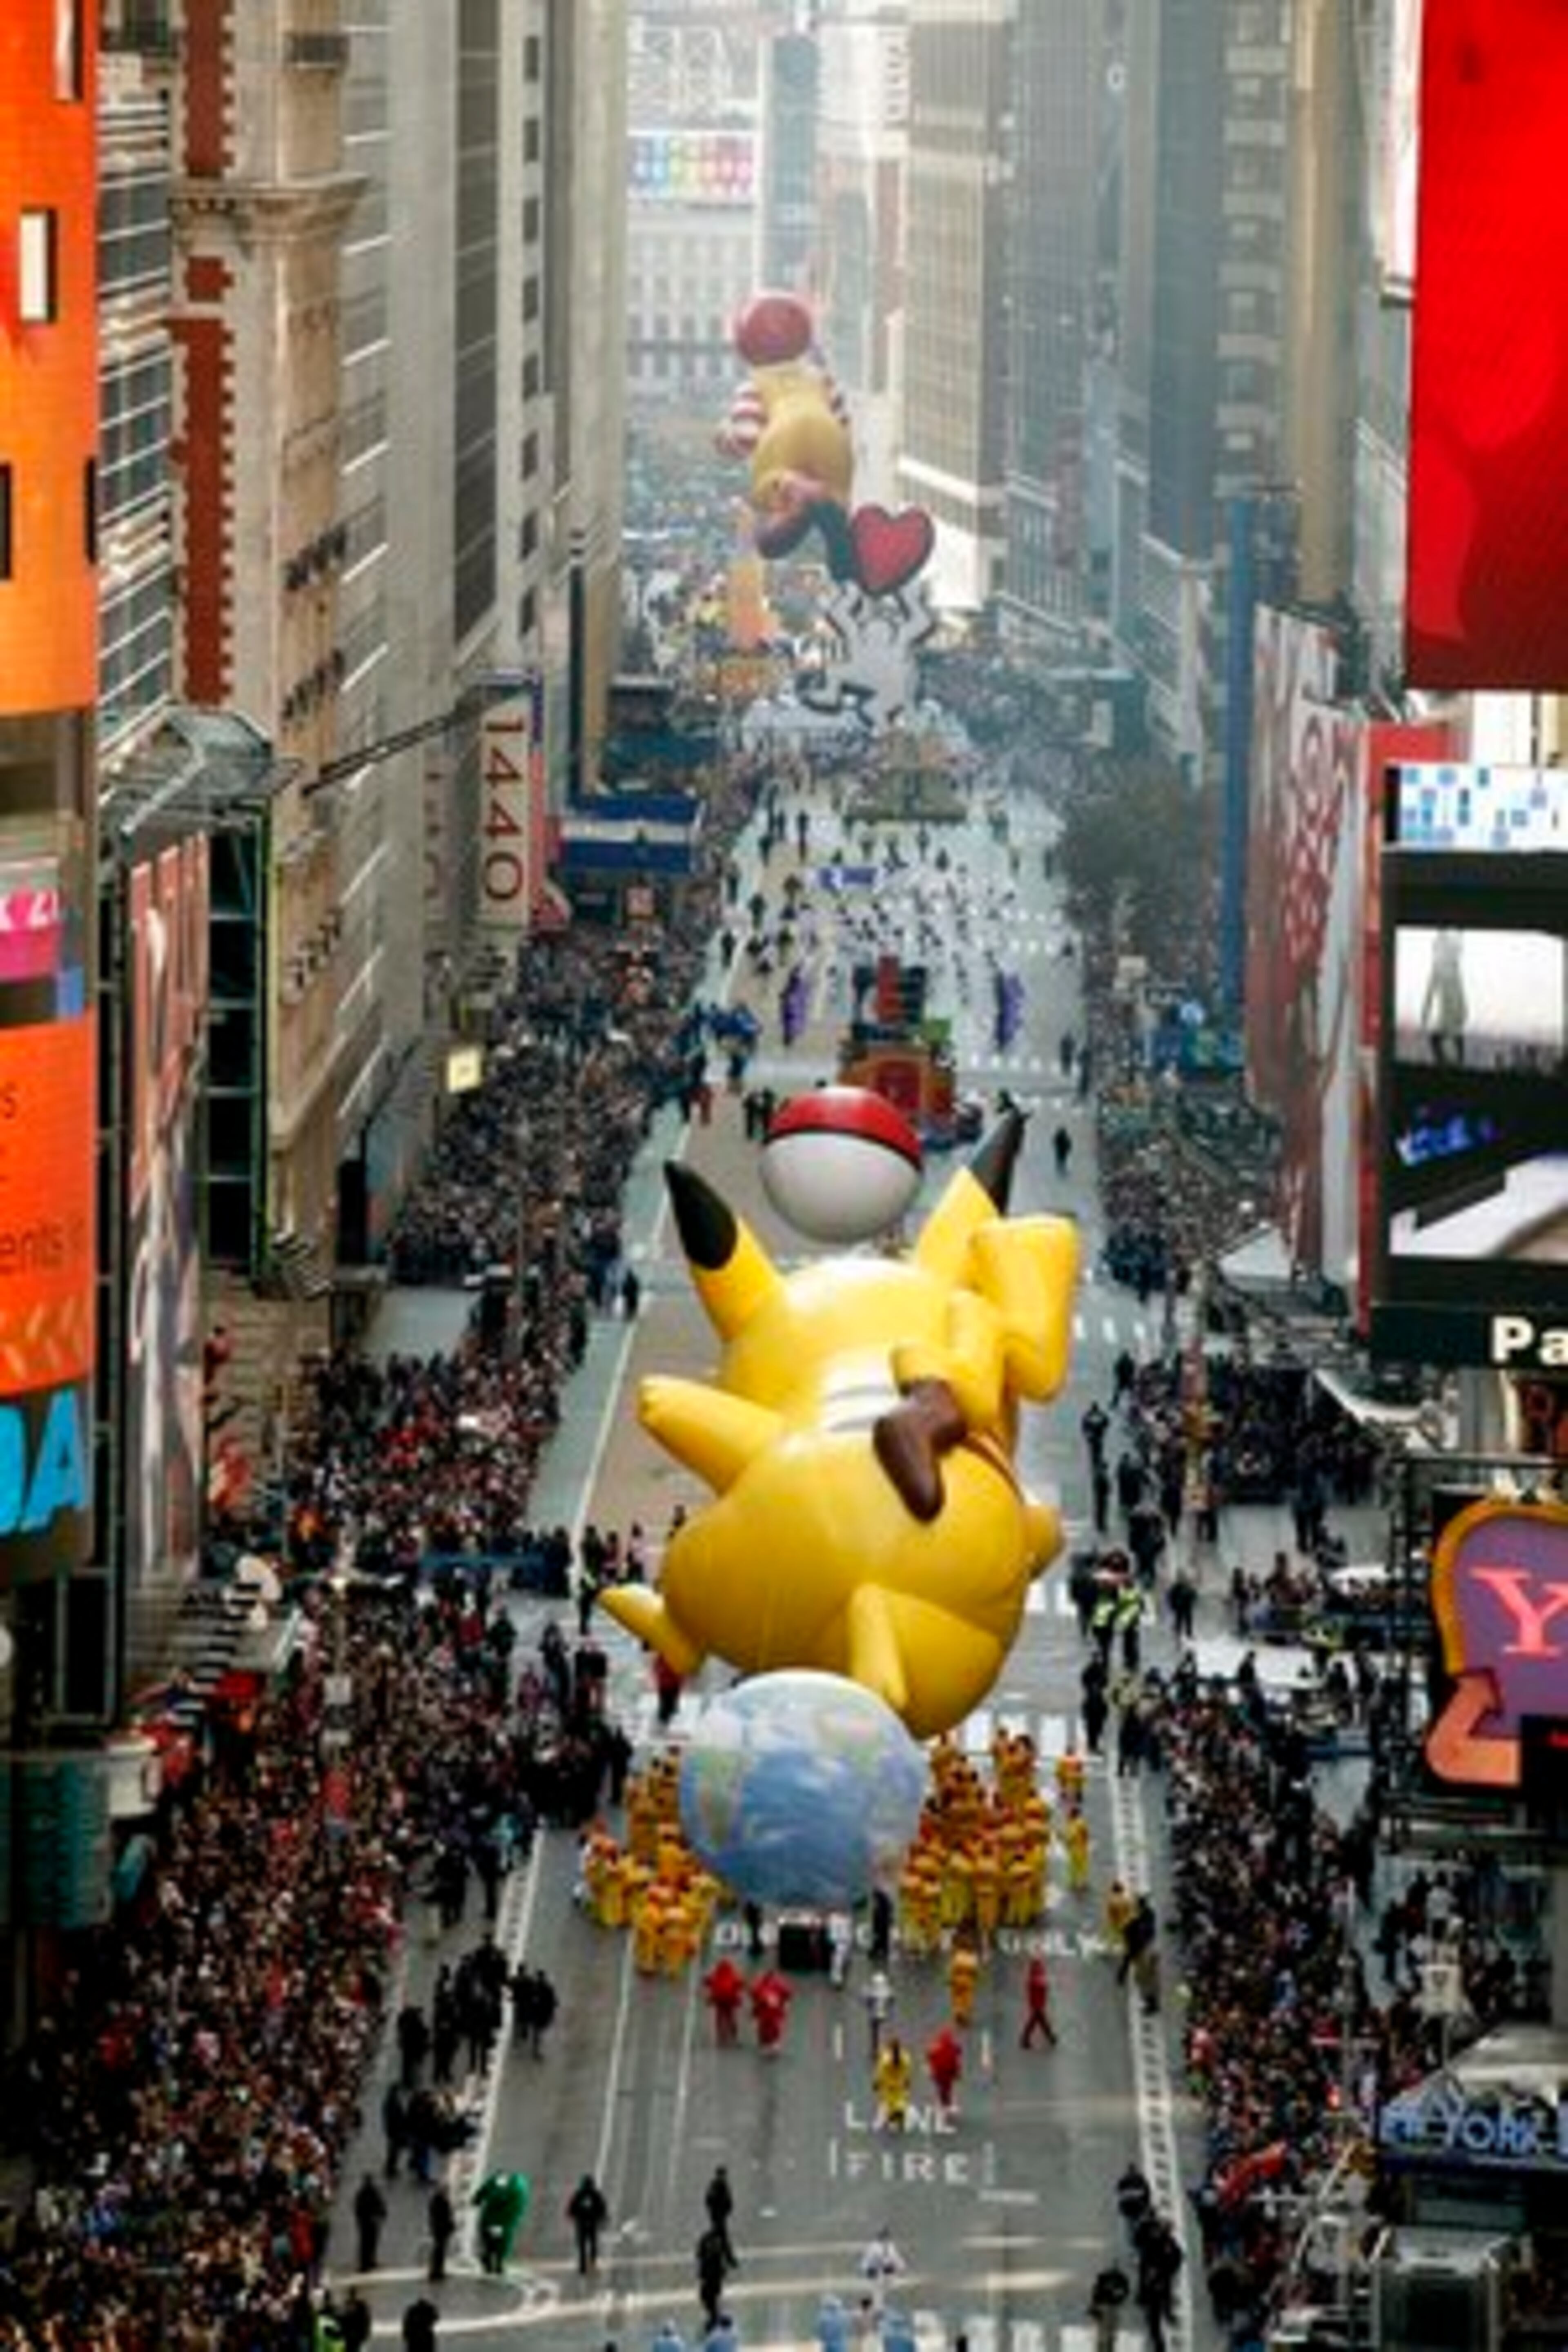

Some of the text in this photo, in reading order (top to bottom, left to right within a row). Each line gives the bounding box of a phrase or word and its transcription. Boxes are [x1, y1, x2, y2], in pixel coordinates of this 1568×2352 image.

[485, 715, 524, 900] 1440
[1493, 1316, 1568, 1365] Pa
[846, 2153, 968, 2183] FIRE
